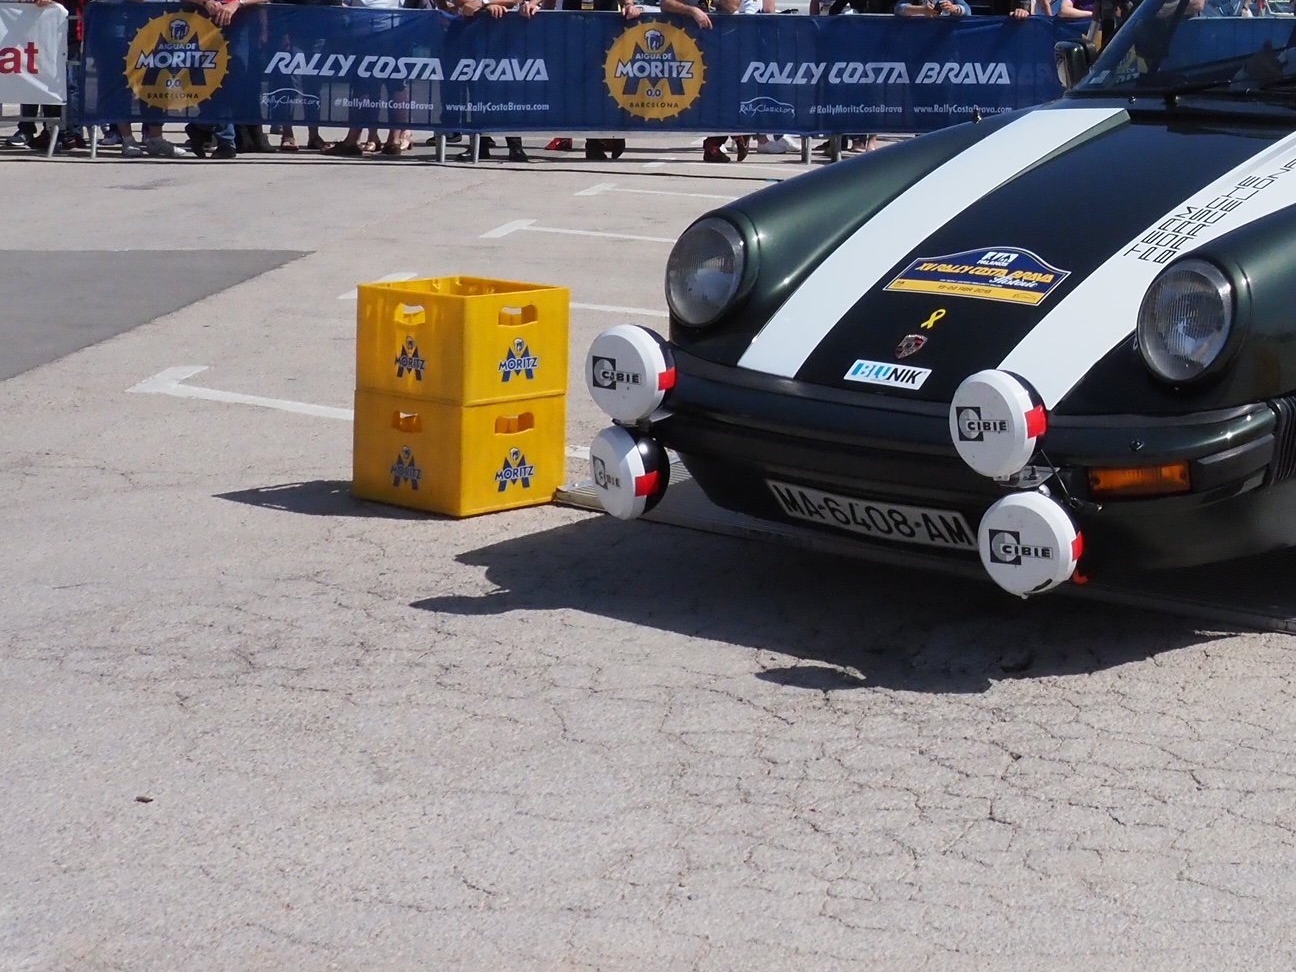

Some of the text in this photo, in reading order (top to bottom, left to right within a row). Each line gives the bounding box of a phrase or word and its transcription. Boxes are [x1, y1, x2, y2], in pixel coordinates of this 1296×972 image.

[135, 51, 217, 69] MORITZ
[264, 51, 550, 81] RALLY COSTA BRAVA
[615, 61, 693, 78] MORITZ
[741, 61, 1011, 84] RALLY COSTA BRAVA
[147, 92, 199, 100] BARCELONA
[334, 98, 434, 111] #RallyMoritzCostaBrava
[445, 102, 550, 113] www.RallyCostaBrava.com
[809, 104, 902, 115] #RallyMoritzCostaBrava
[1138, 175, 1261, 261] PORSCHE
[1123, 206, 1198, 257] TEAM
[932, 263, 973, 274] RALLY
[968, 266, 1009, 277] COSTA
[1008, 270, 1055, 283] BRAVA
[395, 355, 425, 370] MORITZ
[499, 356, 538, 371] MORITZ
[851, 363, 922, 385] BLUNIK
[391, 465, 421, 481] MORITZ
[495, 465, 534, 481] MORITZ
